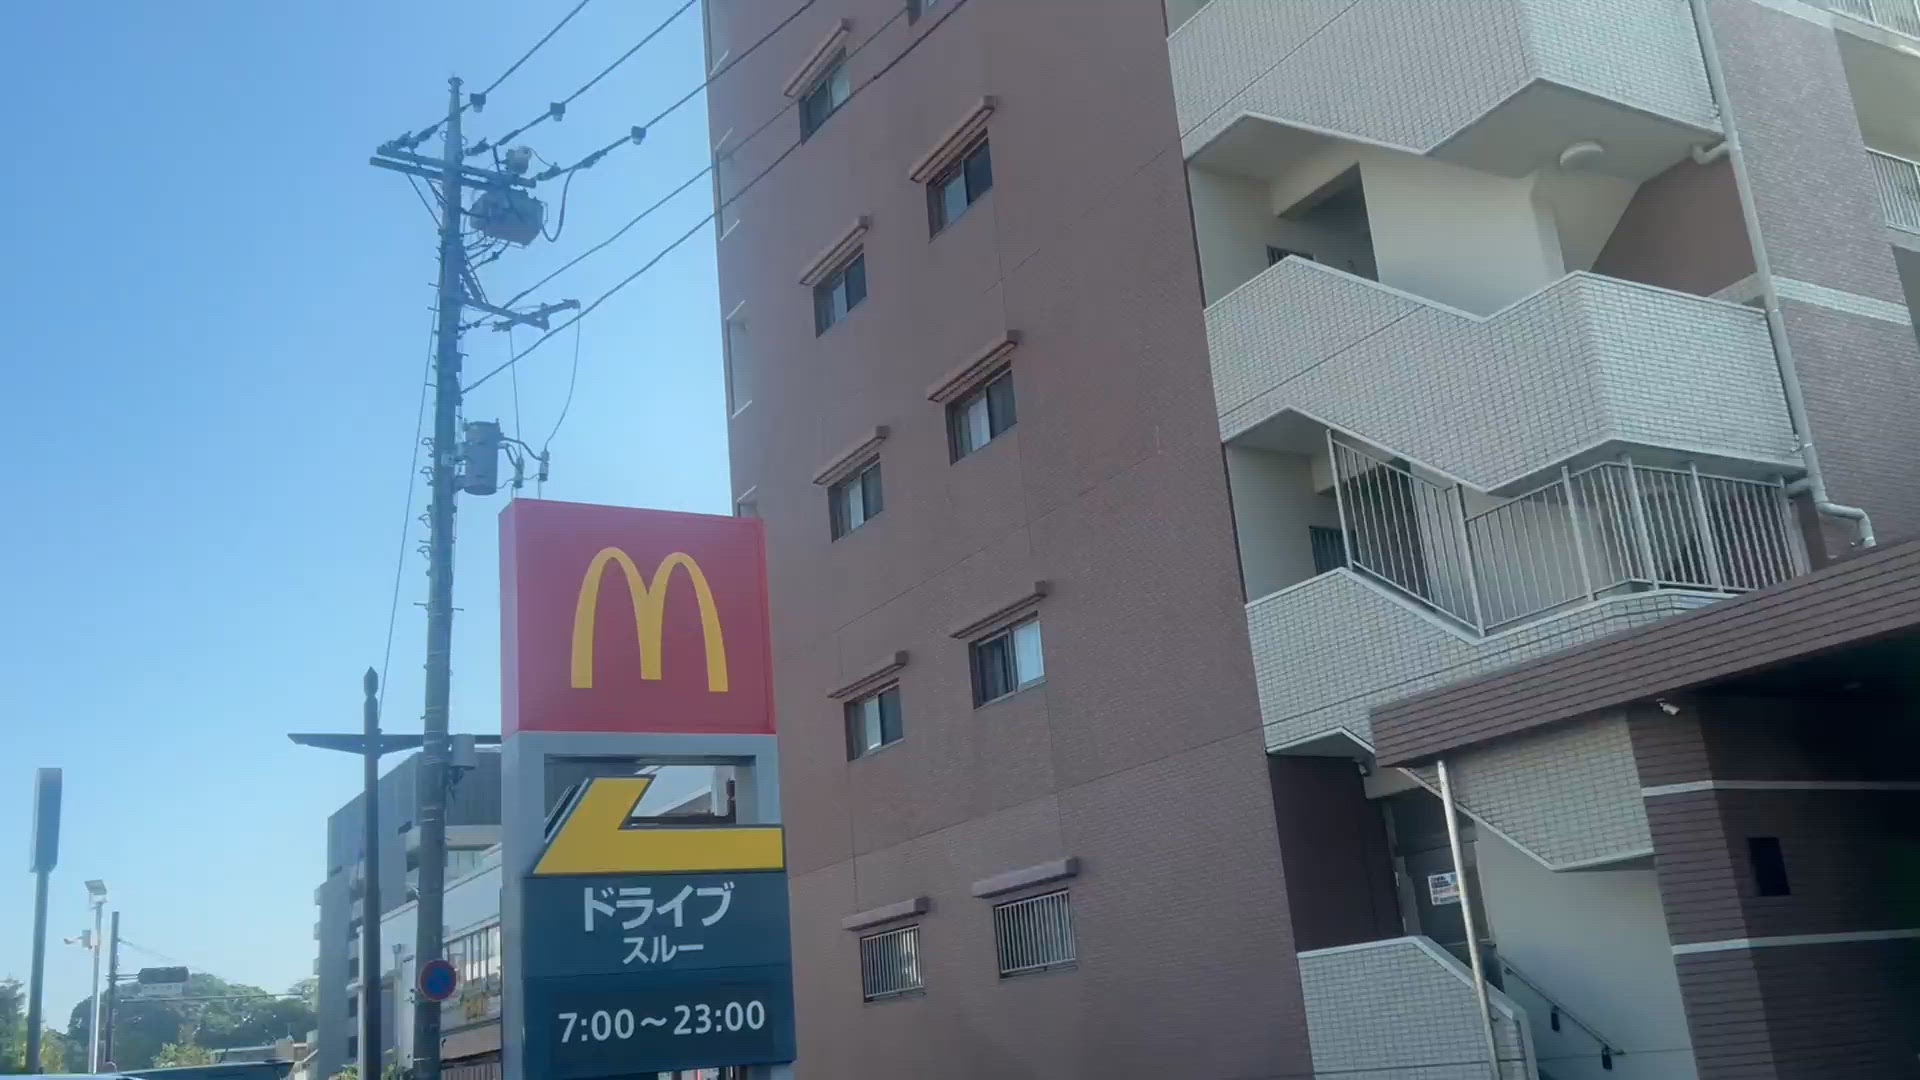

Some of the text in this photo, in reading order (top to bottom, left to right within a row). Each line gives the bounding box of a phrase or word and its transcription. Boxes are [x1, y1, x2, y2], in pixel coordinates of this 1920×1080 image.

[584, 881, 735, 932] ドライブ
[622, 935, 704, 965] スルー
